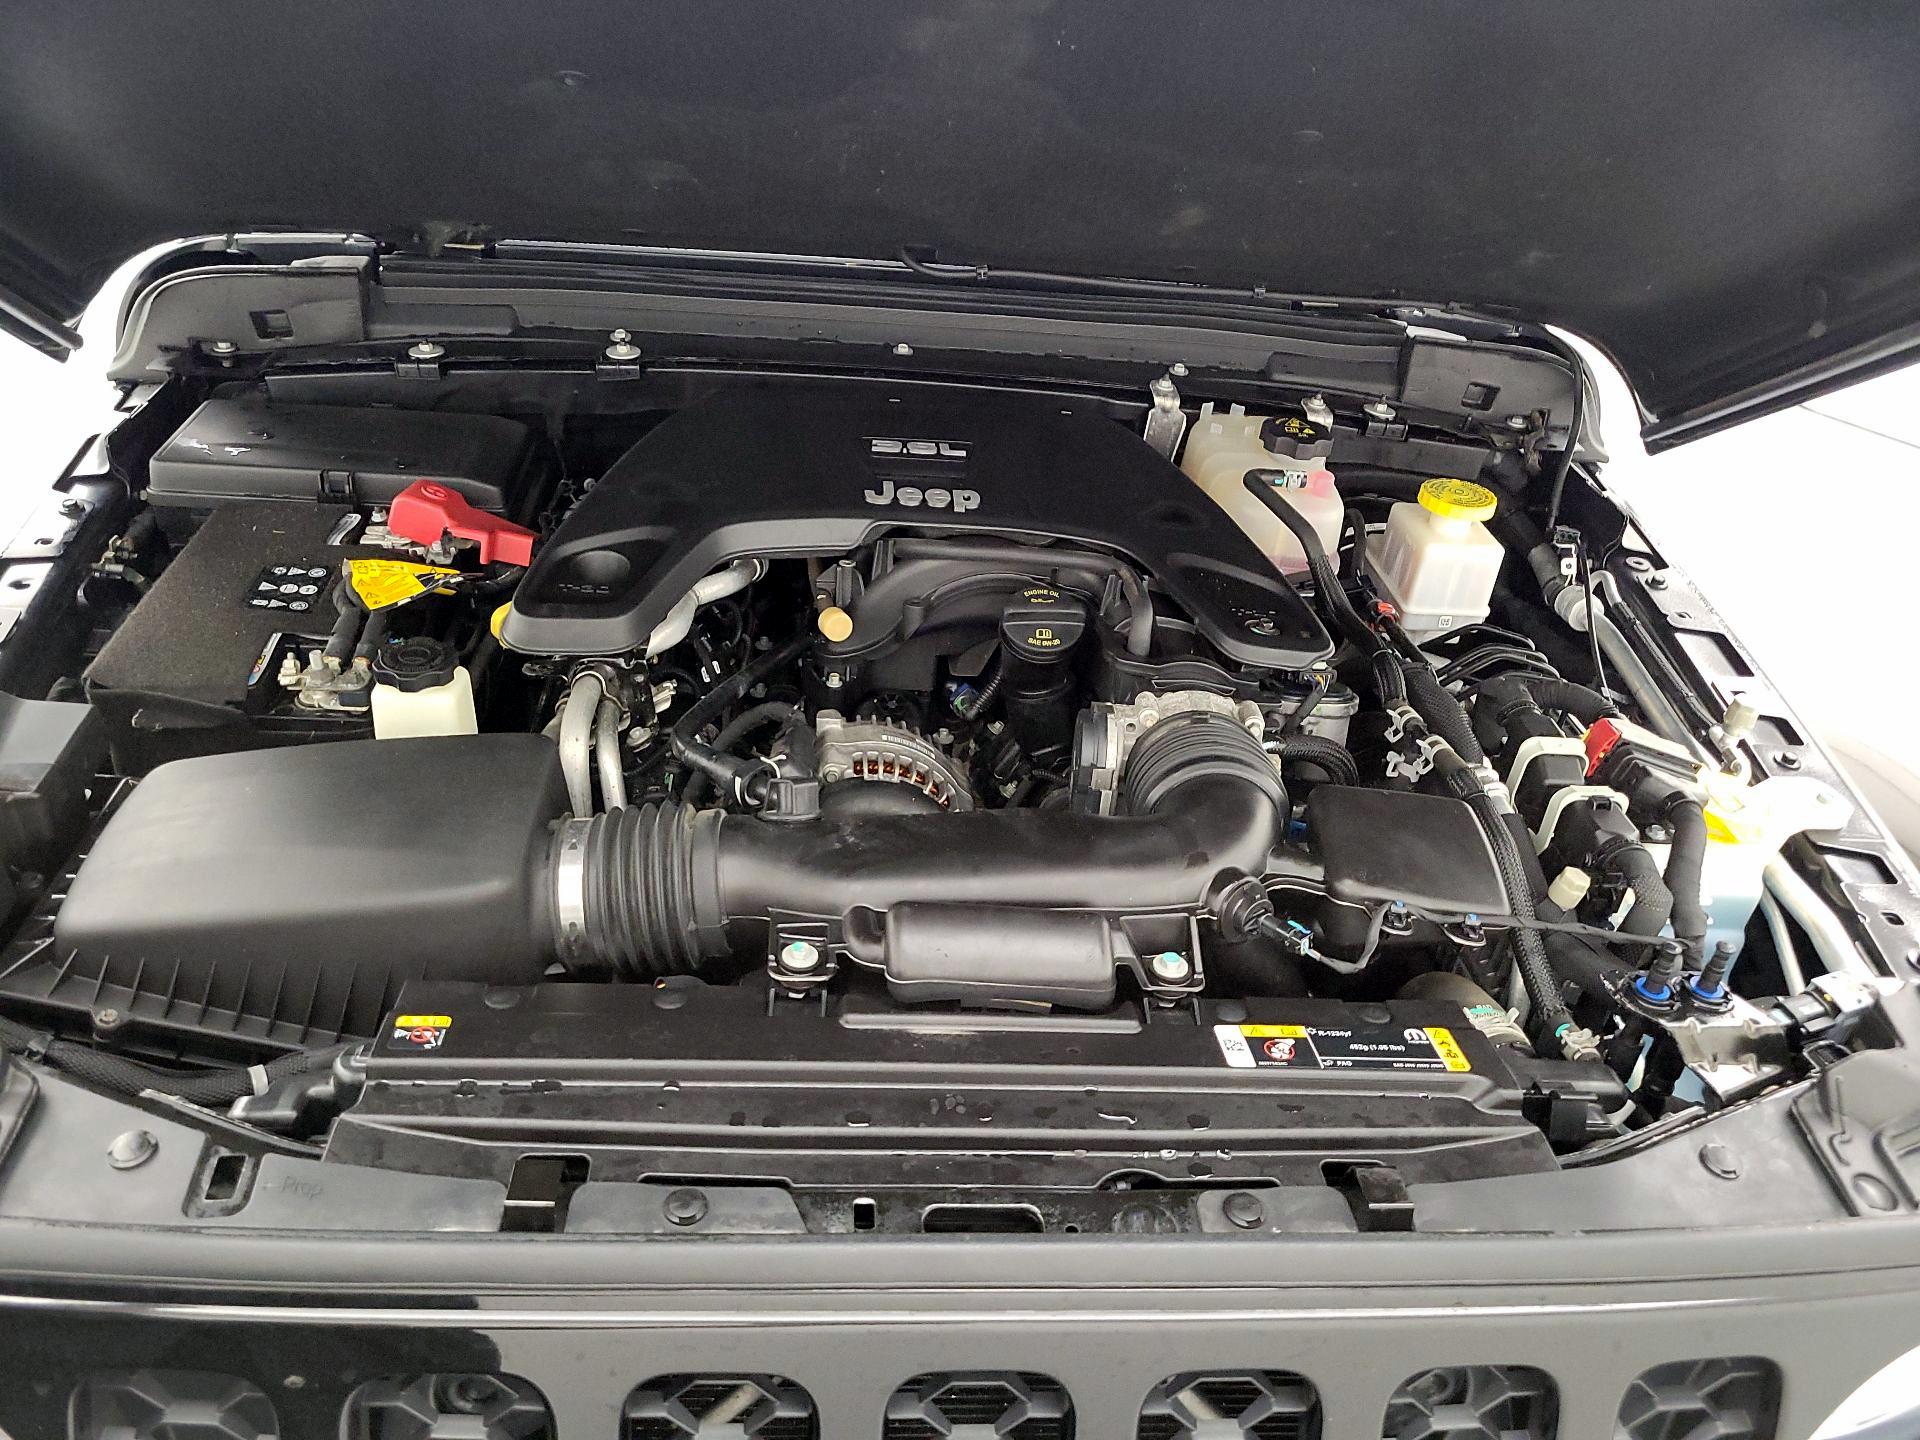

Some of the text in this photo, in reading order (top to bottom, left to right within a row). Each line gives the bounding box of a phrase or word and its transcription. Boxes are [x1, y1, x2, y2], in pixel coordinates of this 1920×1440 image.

[864, 480, 981, 513] Jeep
[1023, 589, 1060, 598] ENGINE OIL
